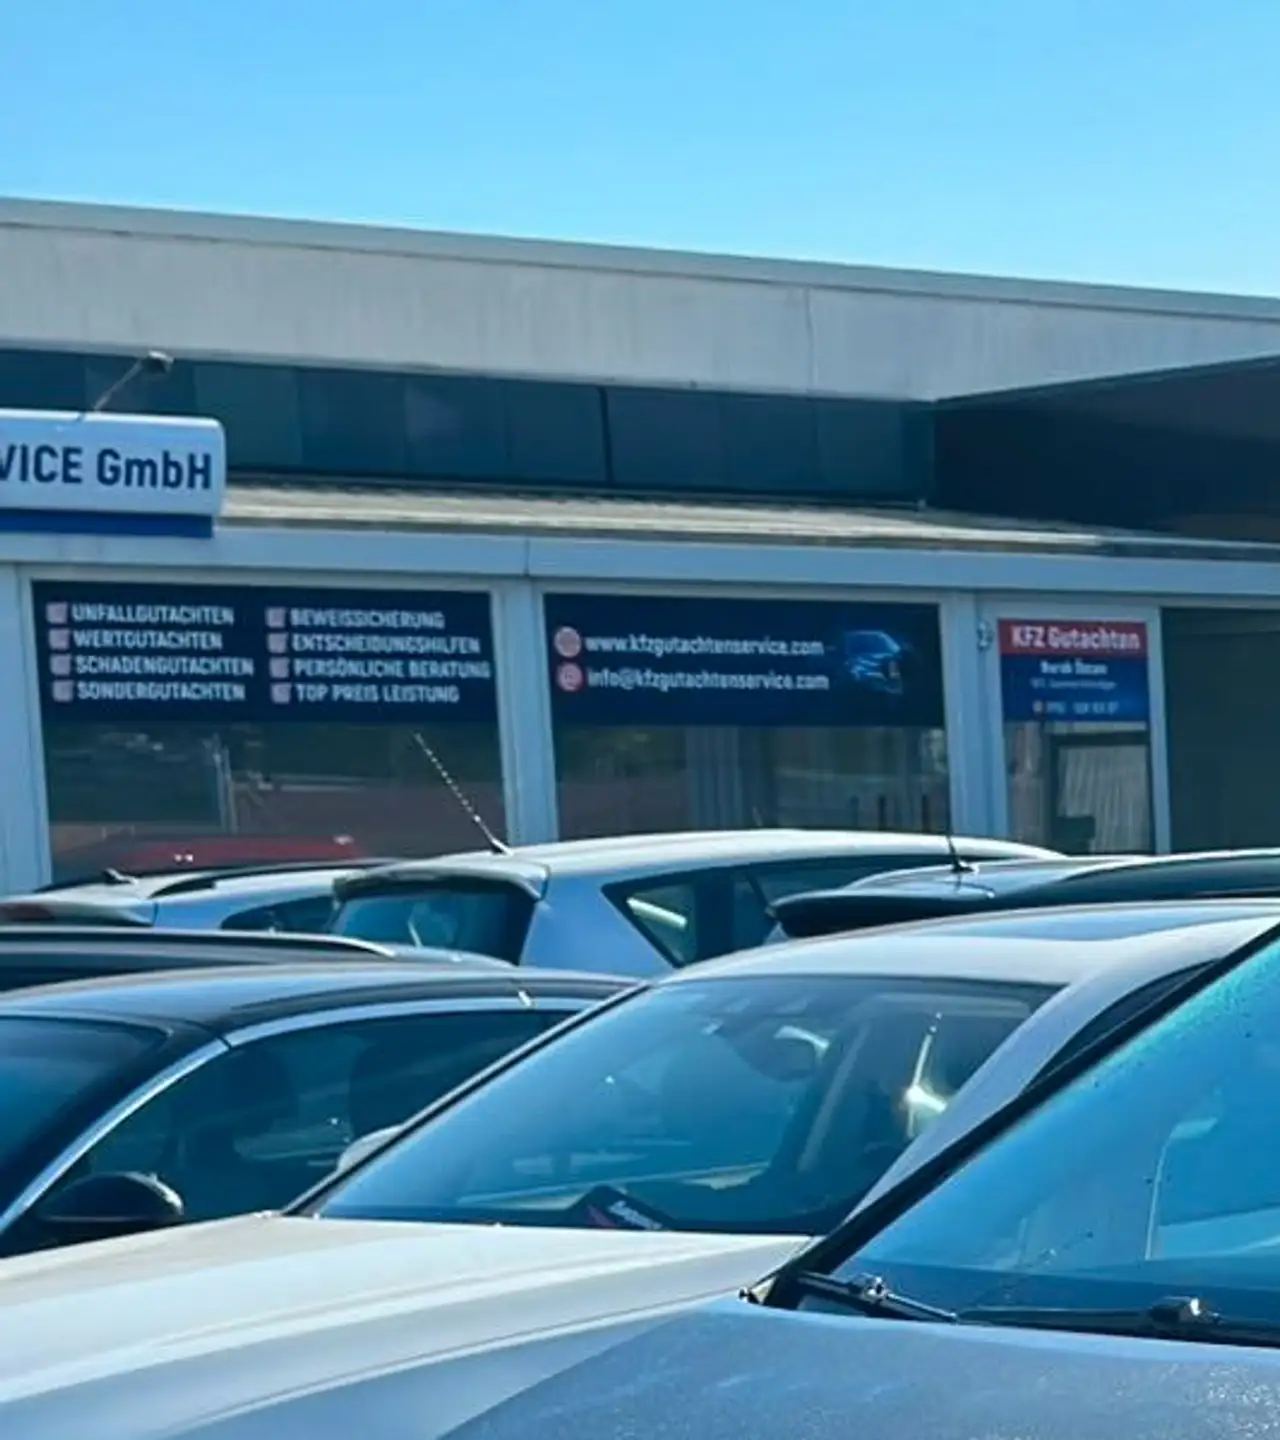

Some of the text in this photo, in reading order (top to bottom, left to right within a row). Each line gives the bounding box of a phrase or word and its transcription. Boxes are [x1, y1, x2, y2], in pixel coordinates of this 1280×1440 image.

[97, 449, 211, 489] GmbH
[72, 604, 234, 625] UNFALLGUTACHTEN
[290, 607, 445, 629] BEWEISSICHERUNG
[73, 629, 222, 650] WERTGUTACHTEN
[584, 634, 824, 657] www.kfzgutachtenservice.com
[1012, 625, 1140, 650] KFZ Gutachten
[75, 654, 254, 676] SCHADENGUTACHTEN
[294, 656, 490, 678] PERSÖNLICHE BERATUNG
[77, 680, 245, 701] SONDERGUTACHTEN
[588, 668, 829, 692] info@kfzgutachtenservice.com
[296, 683, 459, 703] TOP PREIS LEISTUNG
